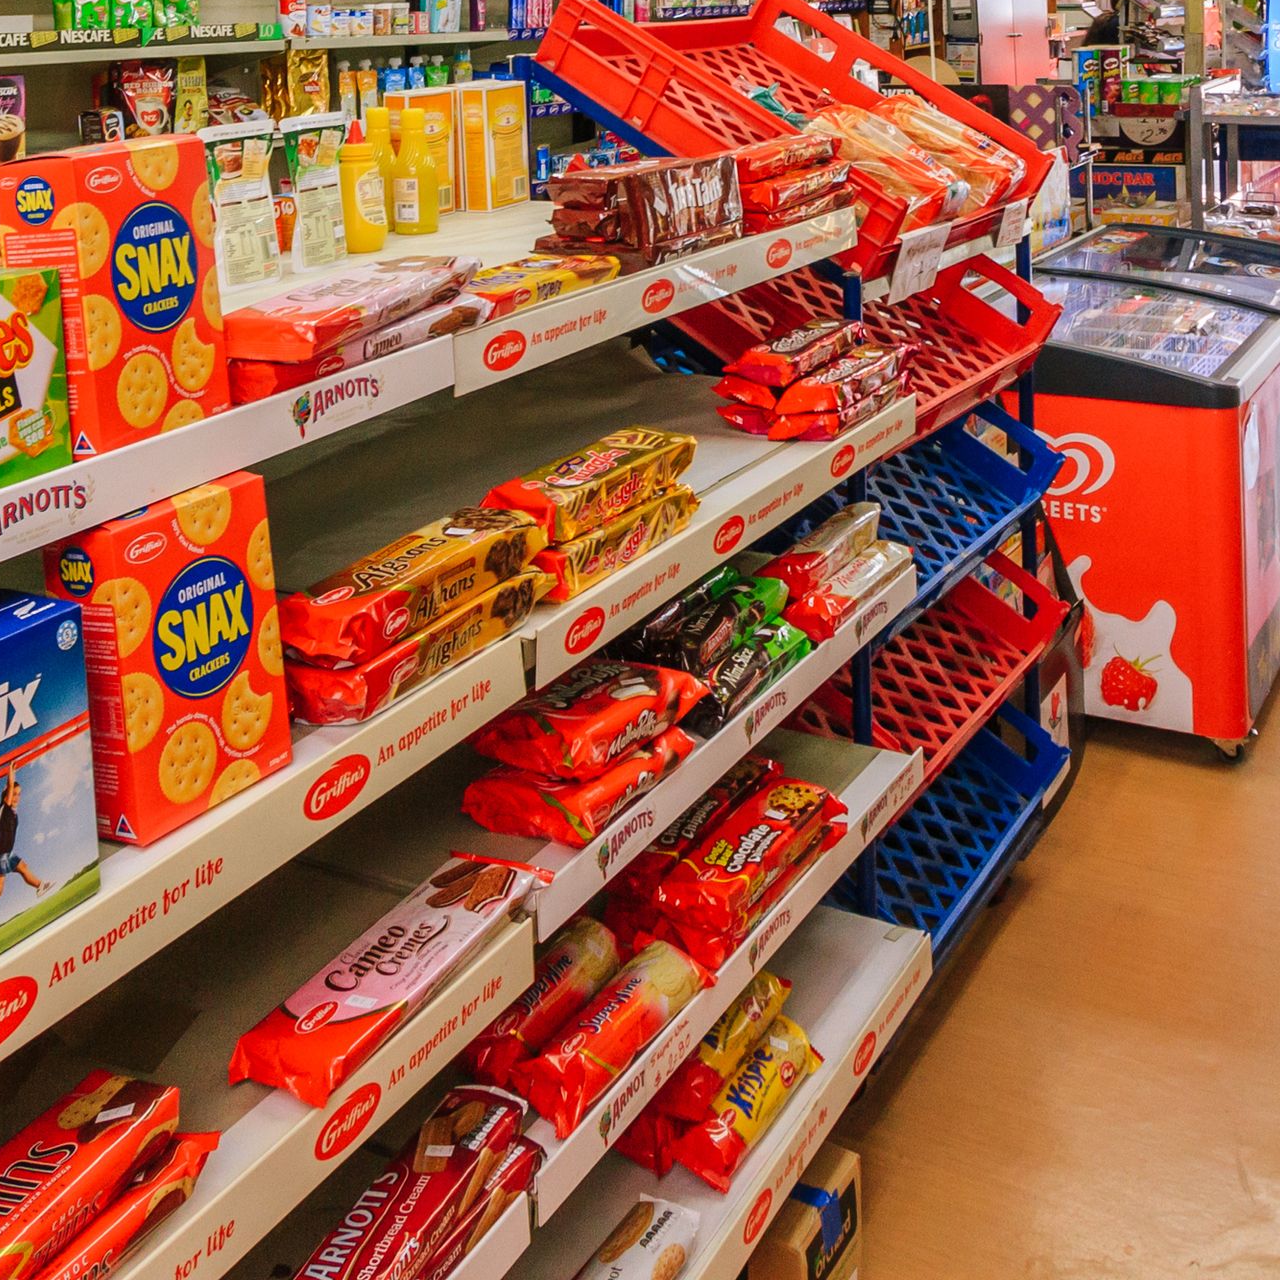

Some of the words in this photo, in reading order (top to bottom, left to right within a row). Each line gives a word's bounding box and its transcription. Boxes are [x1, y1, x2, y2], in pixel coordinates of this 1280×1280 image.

[16, 190, 54, 212] SNAX
[1079, 172, 1121, 184] CHOC
[1124, 173, 1155, 185] BAR
[133, 220, 175, 240] ORIGINAL
[114, 232, 195, 300] SNAX
[143, 296, 179, 316] CRACKERS
[363, 332, 402, 360] Cameo
[312, 374, 379, 424] ARNOTT'S
[1043, 501, 1101, 523] REETS
[61, 560, 92, 583] SNAX
[177, 573, 227, 604] ORIGINAL
[353, 535, 447, 593] Afghans
[414, 572, 475, 628] Afghans
[158, 587, 250, 671] SNAX
[421, 619, 482, 673] Afghans
[189, 652, 231, 682] CRACKERS
[310, 764, 365, 814] Griffin's
[377, 743, 395, 767] An
[397, 709, 447, 753] appetite
[450, 696, 468, 723] for
[471, 680, 492, 706] life
[727, 823, 771, 873] Chocolate
[48, 960, 77, 988] An
[81, 902, 158, 964] appetite
[161, 880, 192, 923] for
[194, 855, 225, 890] life
[324, 923, 406, 992] Cameo
[322, 1092, 377, 1154] Griffin's
[387, 1063, 410, 1089] An
[411, 1012, 459, 1071] appetite
[460, 996, 481, 1027] for
[482, 974, 503, 1005] life
[726, 1046, 773, 1120] Krispie
[22, 1192, 42, 1212] NEVER
[42, 1165, 72, 1190] ENOUGH
[358, 1216, 406, 1280] Shortbread
[399, 1175, 431, 1212] Cream
[431, 1206, 455, 1245] Cream
